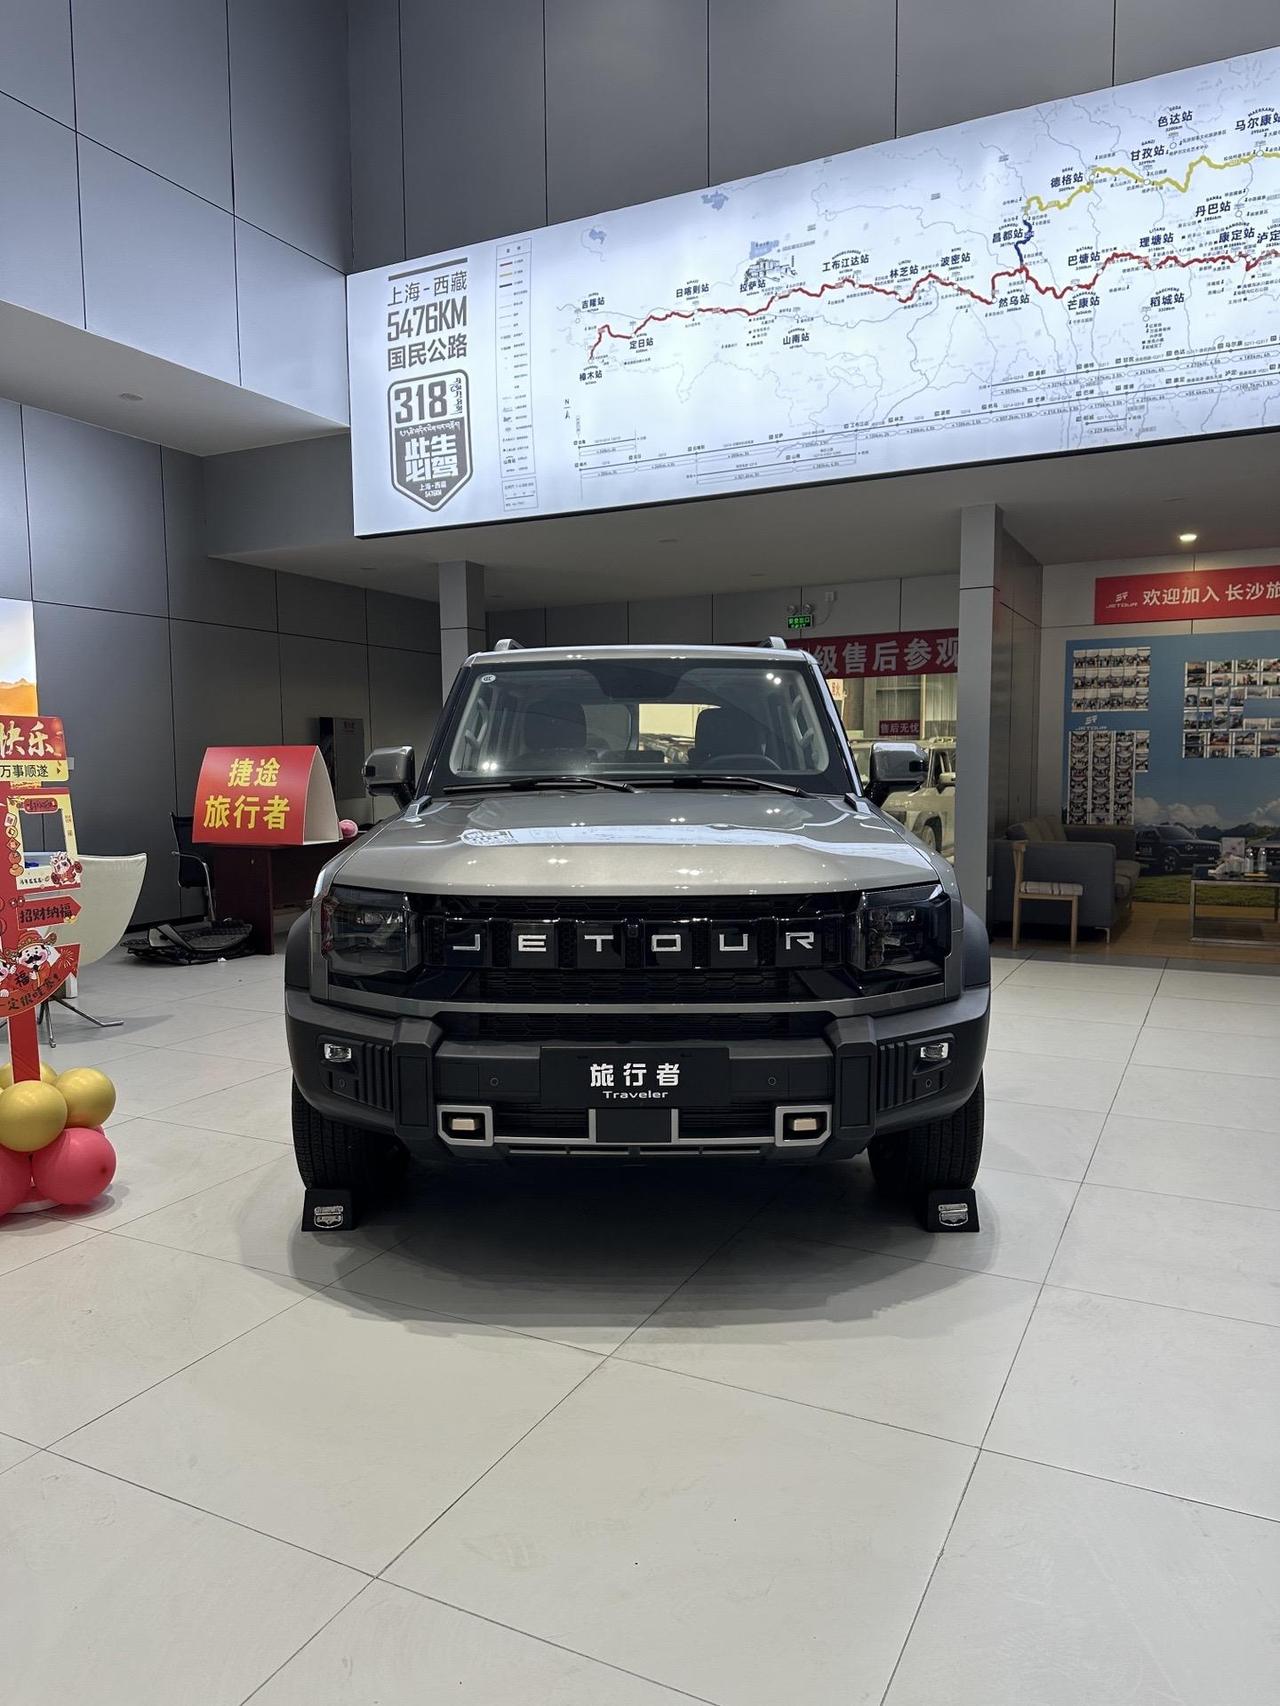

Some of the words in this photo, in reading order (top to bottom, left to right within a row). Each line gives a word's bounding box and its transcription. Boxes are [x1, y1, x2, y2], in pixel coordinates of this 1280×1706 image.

[1157, 110, 1193, 128] 色达站
[1130, 144, 1165, 162] 甘孜站
[1050, 172, 1084, 188] 德格站
[1195, 200, 1231, 217] 丹巴站
[992, 228, 1024, 243] 昌都站
[1139, 232, 1174, 248] 理塘站
[1219, 227, 1255, 244] 康定站
[822, 254, 870, 272] 工布江达站
[940, 252, 971, 267] 波密站
[1068, 251, 1100, 266] 巴塘站
[890, 264, 919, 280] 林芝站
[387, 270, 467, 307] 上海-西藏
[675, 283, 709, 298] 日喀则站
[739, 279, 767, 293] 拉萨站
[582, 296, 605, 309] 吉隆站
[998, 294, 1030, 309] 然乌站
[1067, 296, 1100, 311] 芒康站
[1150, 292, 1184, 308] 稻城站
[387, 295, 467, 342] 5476KM
[629, 338, 654, 350] 定日站
[782, 332, 810, 346] 山南站
[387, 333, 467, 371] 国民公路
[579, 370, 603, 383] 樟木站
[394, 380, 448, 424] 318
[405, 434, 457, 460] 此生
[405, 455, 459, 482] 必驾
[1143, 585, 1220, 606] 欢迎加入
[1225, 581, 1280, 601] 长沙旅
[808, 637, 958, 675] 级售后参观
[880, 723, 920, 734] 售后无忧
[0, 720, 54, 759] 快乐
[0, 764, 49, 778] 万事顺遂
[228, 757, 281, 787] 捷途
[203, 794, 291, 829] 旅行者
[19, 903, 72, 923] 招财纳福
[453, 932, 814, 953] JETOUR
[590, 1062, 680, 1087] 旅行者
[602, 1090, 669, 1099] Traveler
